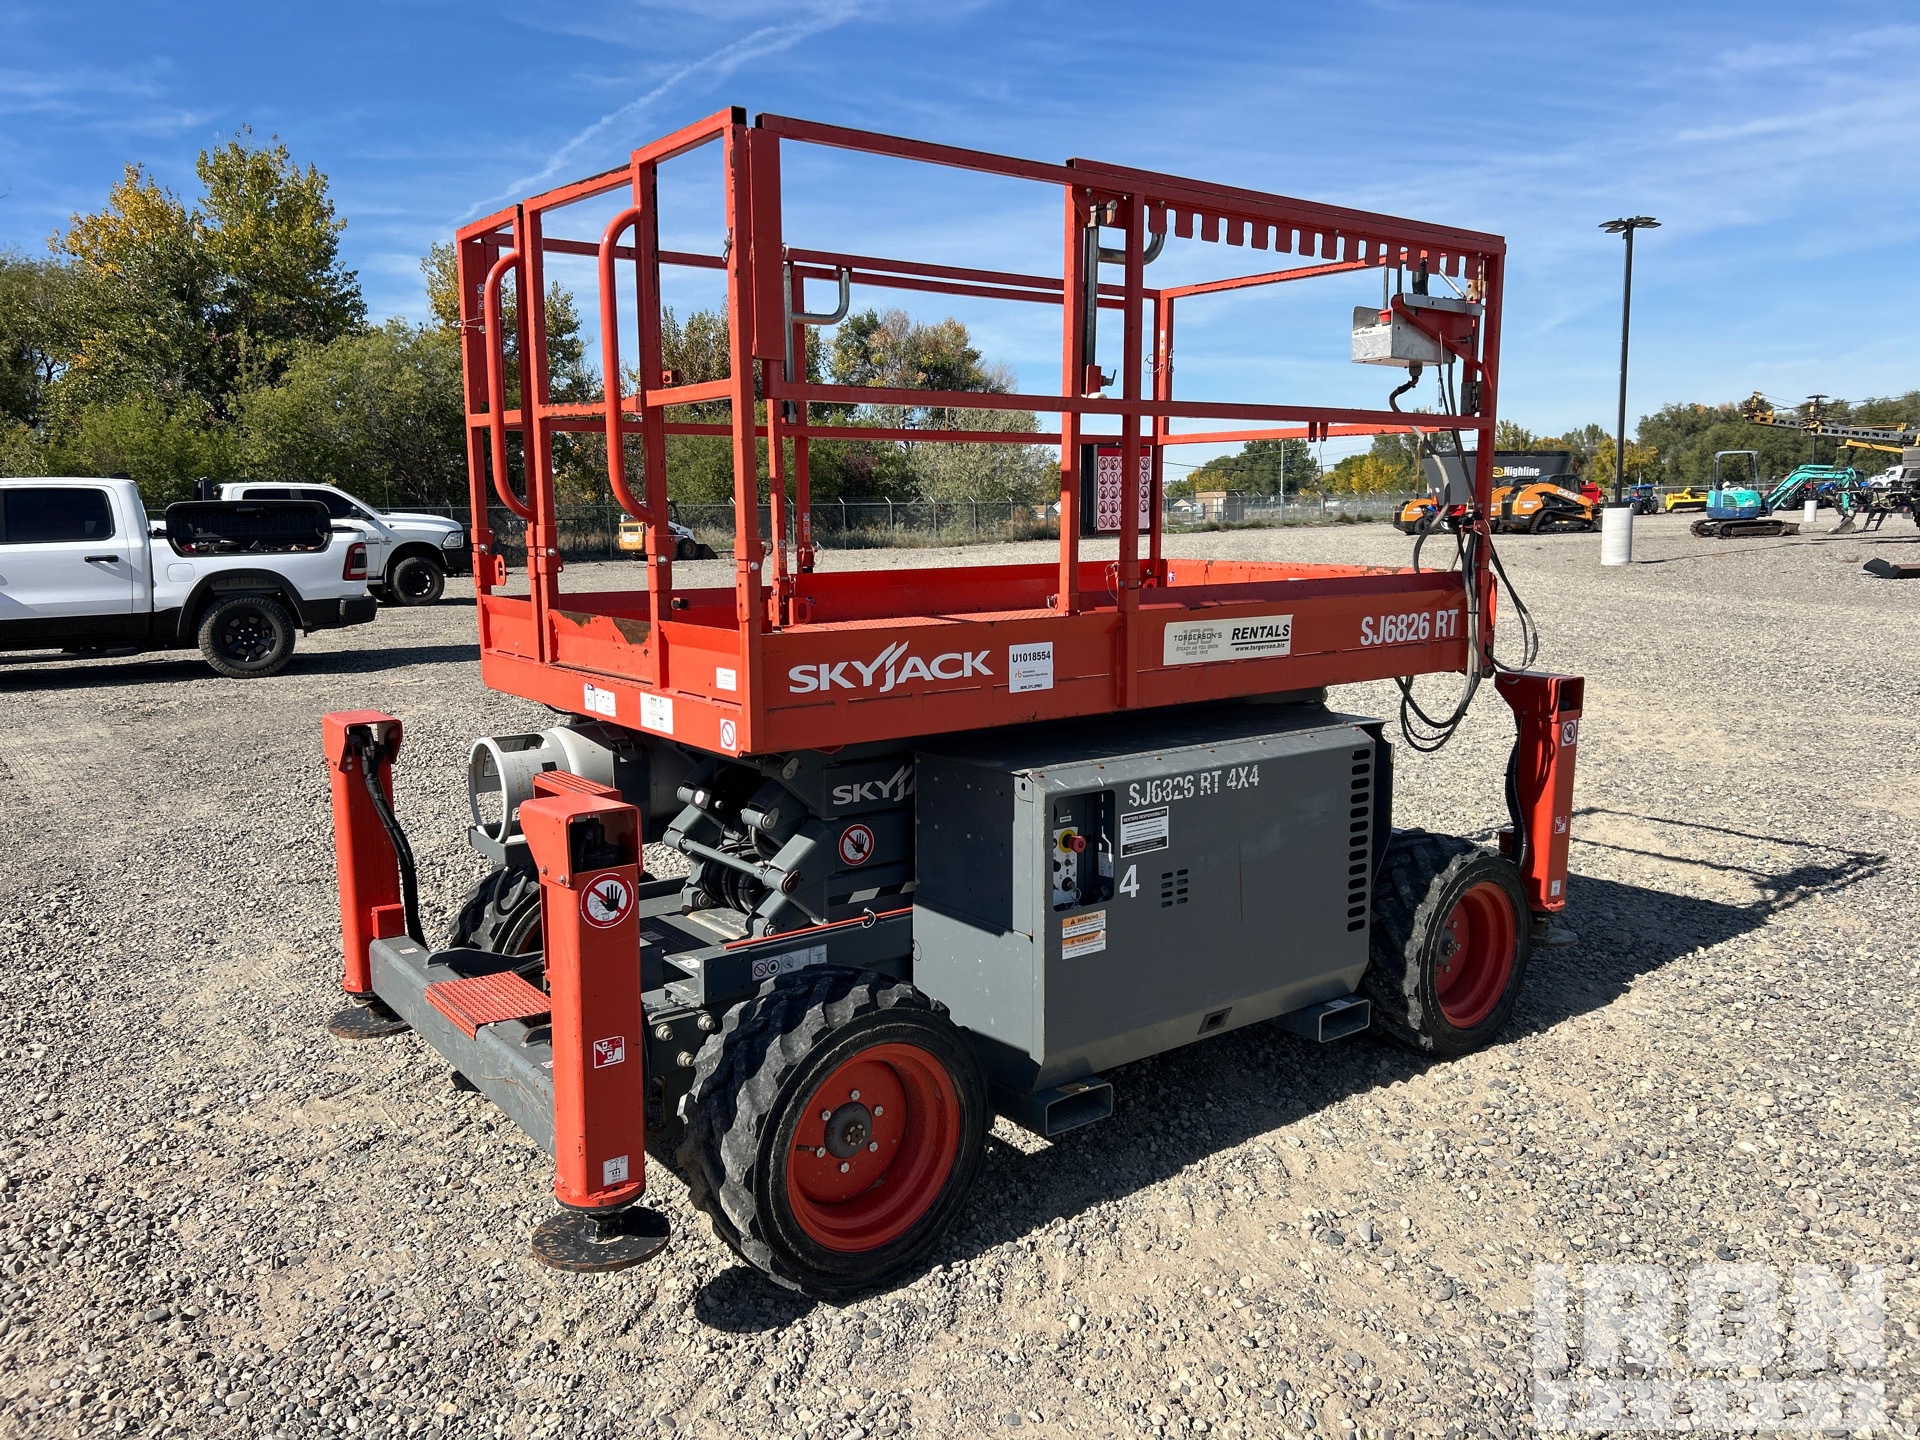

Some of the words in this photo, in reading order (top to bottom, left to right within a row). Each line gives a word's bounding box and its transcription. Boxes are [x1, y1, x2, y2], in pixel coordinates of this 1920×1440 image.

[1504, 466, 1540, 477] Highline
[1557, 489, 1580, 501] CASE
[1231, 624, 1290, 640] RENTALS
[1360, 612, 1430, 646] SJ6826
[1435, 609, 1459, 638] RT
[1235, 643, 1285, 651] www.torgerson.biz
[1012, 651, 1051, 663] U1018554
[788, 640, 994, 693] SKYJACK
[1200, 770, 1222, 796] RT
[1226, 764, 1260, 790] 4X4
[1119, 864, 1140, 898] 4
[1077, 914, 1099, 923] WARNING
